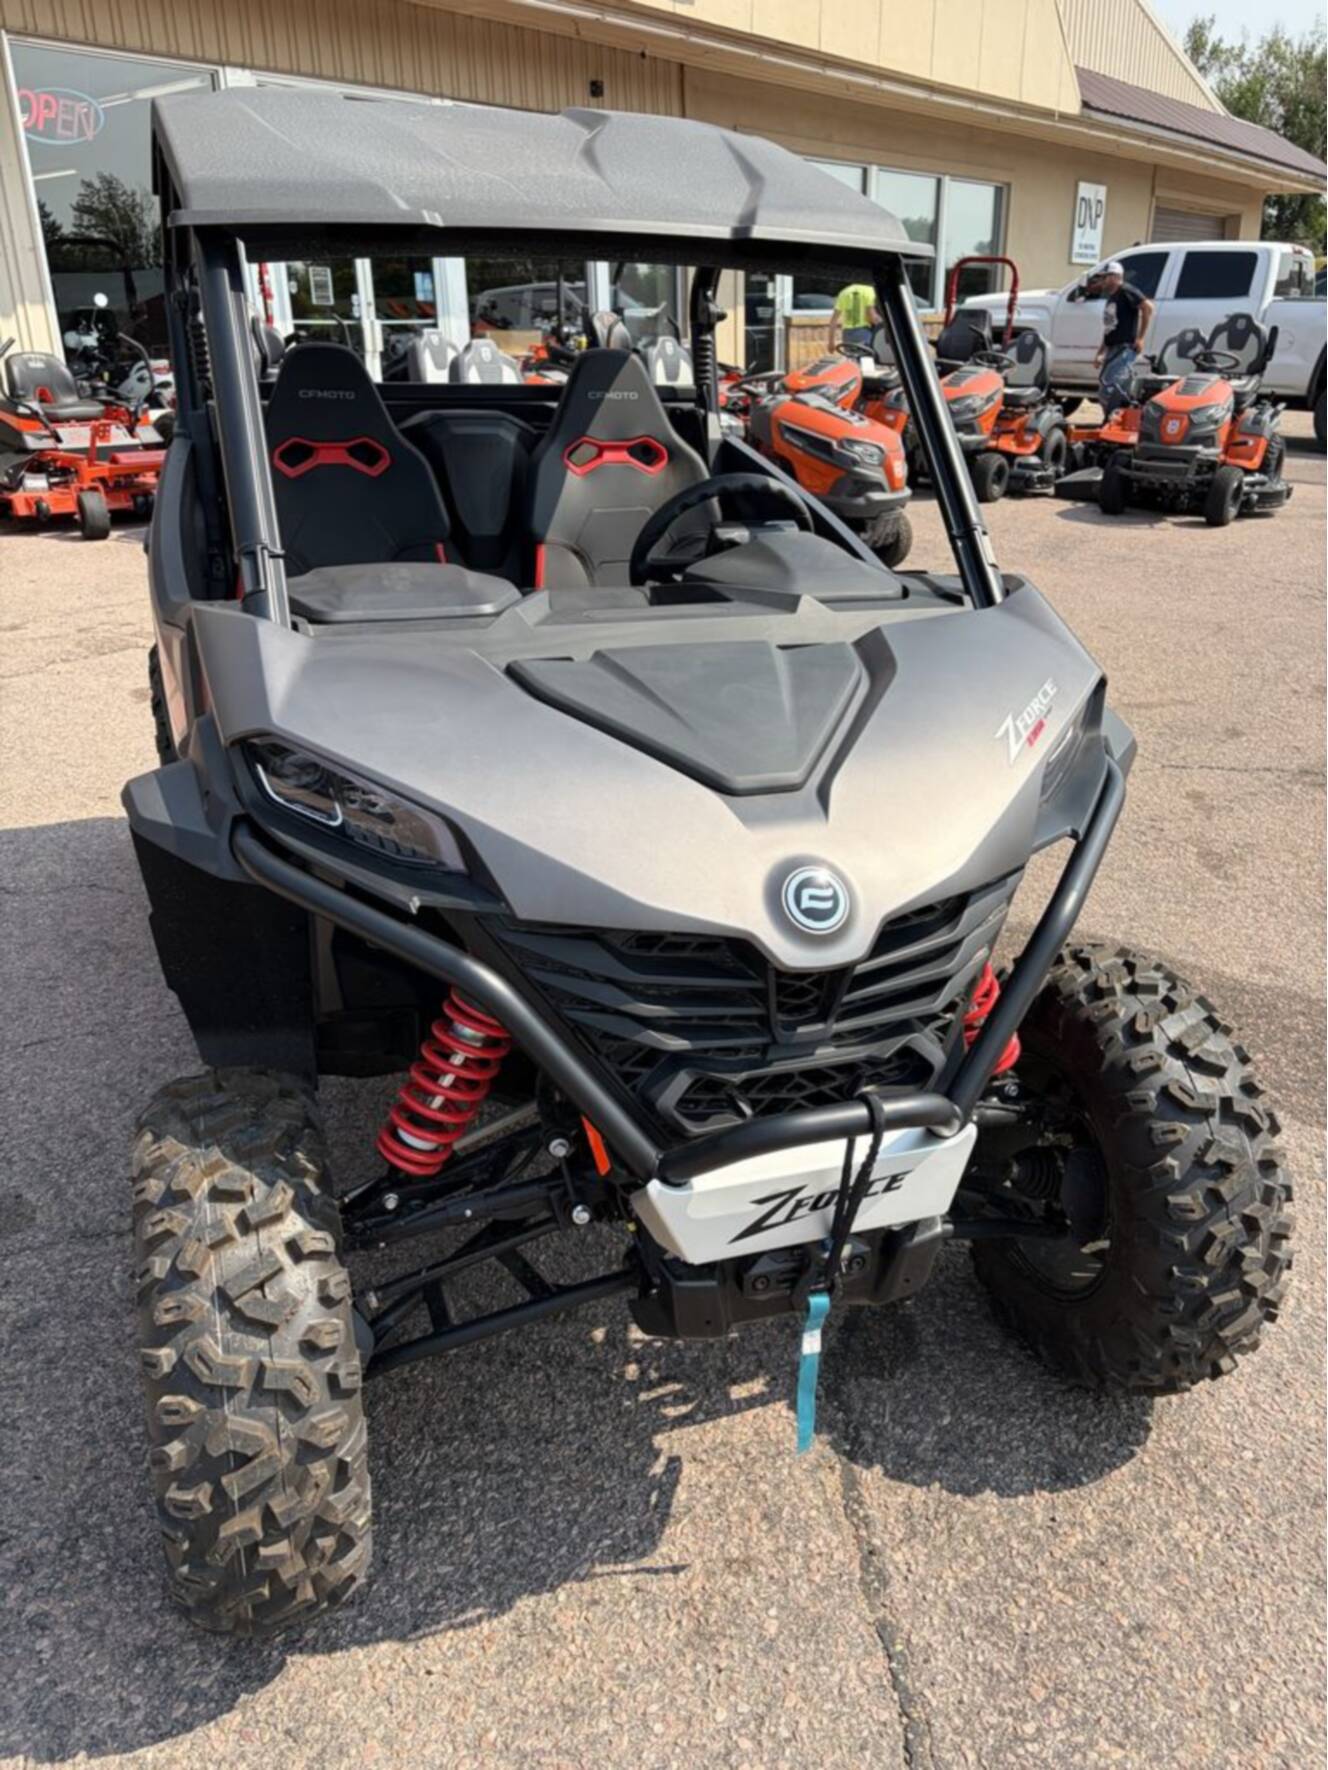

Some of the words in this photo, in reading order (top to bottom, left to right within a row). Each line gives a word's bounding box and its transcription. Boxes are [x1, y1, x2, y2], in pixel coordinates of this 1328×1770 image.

[18, 89, 95, 140] OPEN
[994, 677, 1057, 766] ZFORCE
[727, 1169, 915, 1244] ZFOCE
